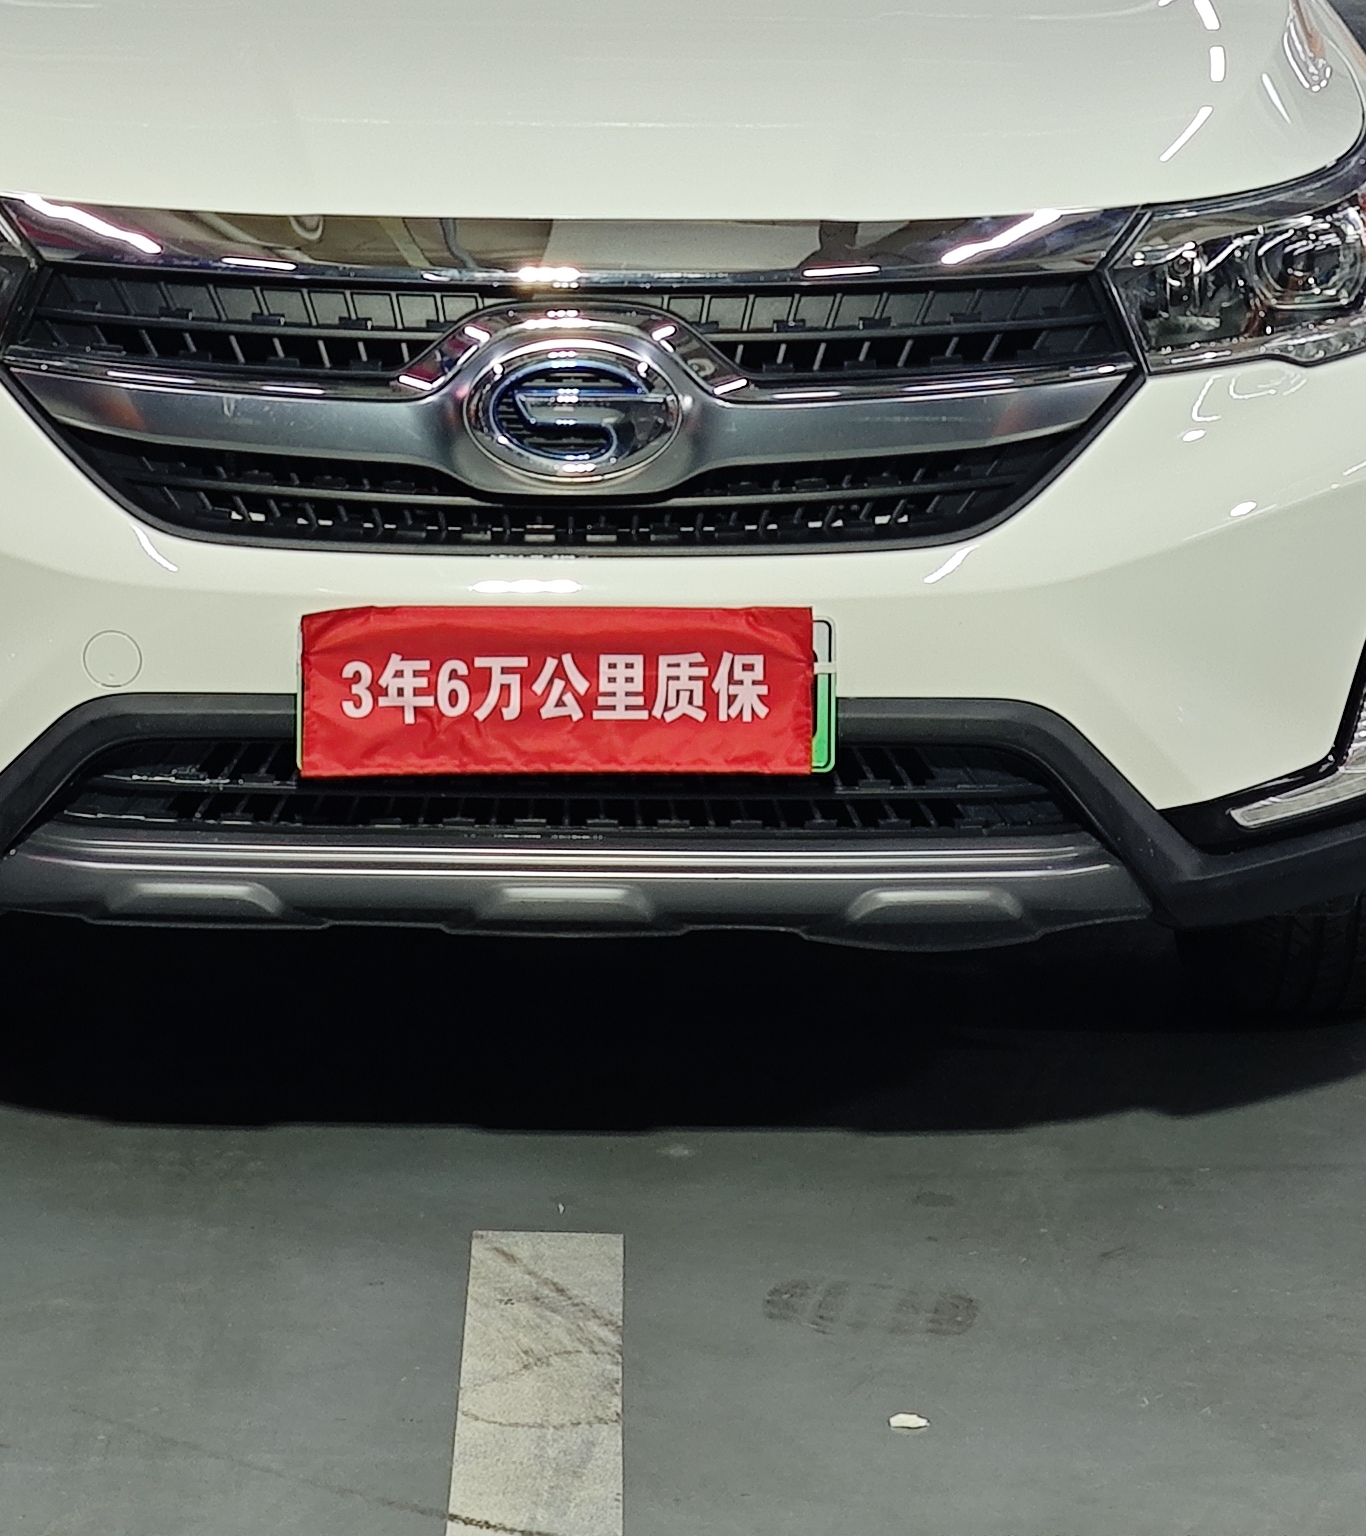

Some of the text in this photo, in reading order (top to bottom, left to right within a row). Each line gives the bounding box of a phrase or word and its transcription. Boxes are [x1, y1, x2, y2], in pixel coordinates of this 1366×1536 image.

[341, 652, 770, 725] 3年6万公里质保
